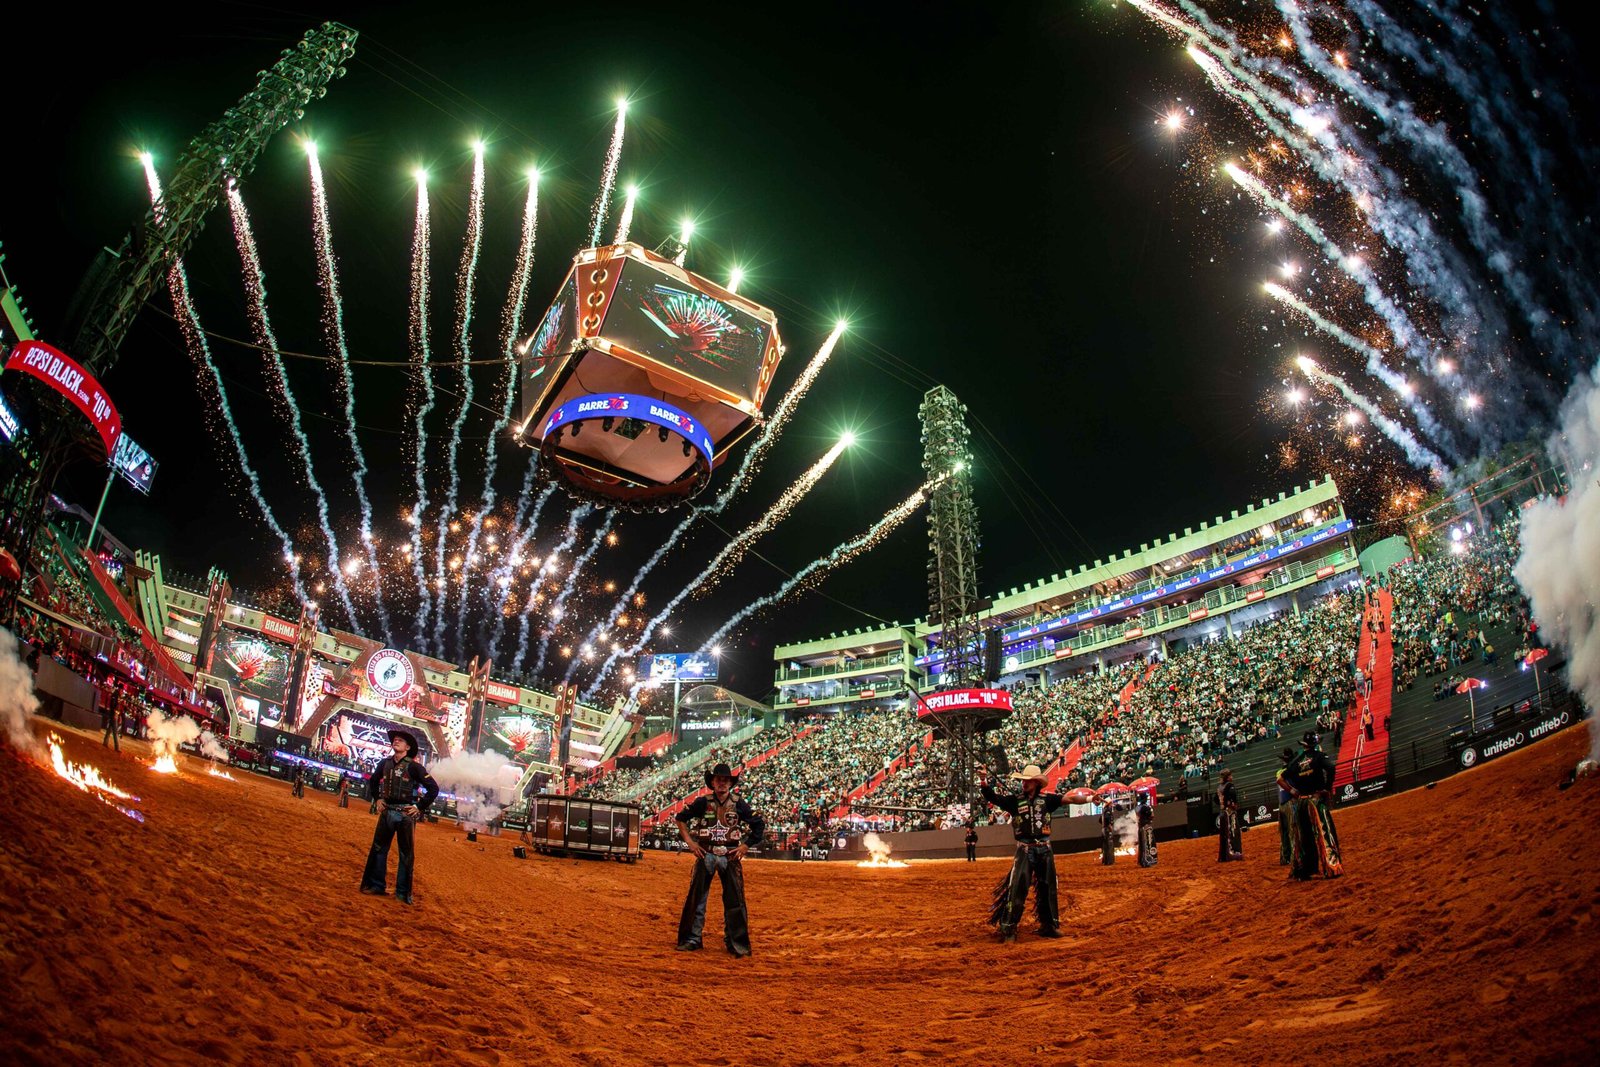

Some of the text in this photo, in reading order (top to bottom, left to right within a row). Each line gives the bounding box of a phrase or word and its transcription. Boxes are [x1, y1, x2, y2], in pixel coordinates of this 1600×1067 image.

[23, 347, 53, 372] PEPSI
[47, 357, 84, 394] BLACK
[265, 619, 295, 638] BRAHMA
[373, 683, 403, 698] BARRETOS
[487, 684, 517, 701] BRAHMA
[926, 695, 944, 710] PEPSI
[945, 692, 970, 706] BLACK
[703, 721, 719, 729] GOLD
[1484, 717, 1560, 757] unifeb unifeb
